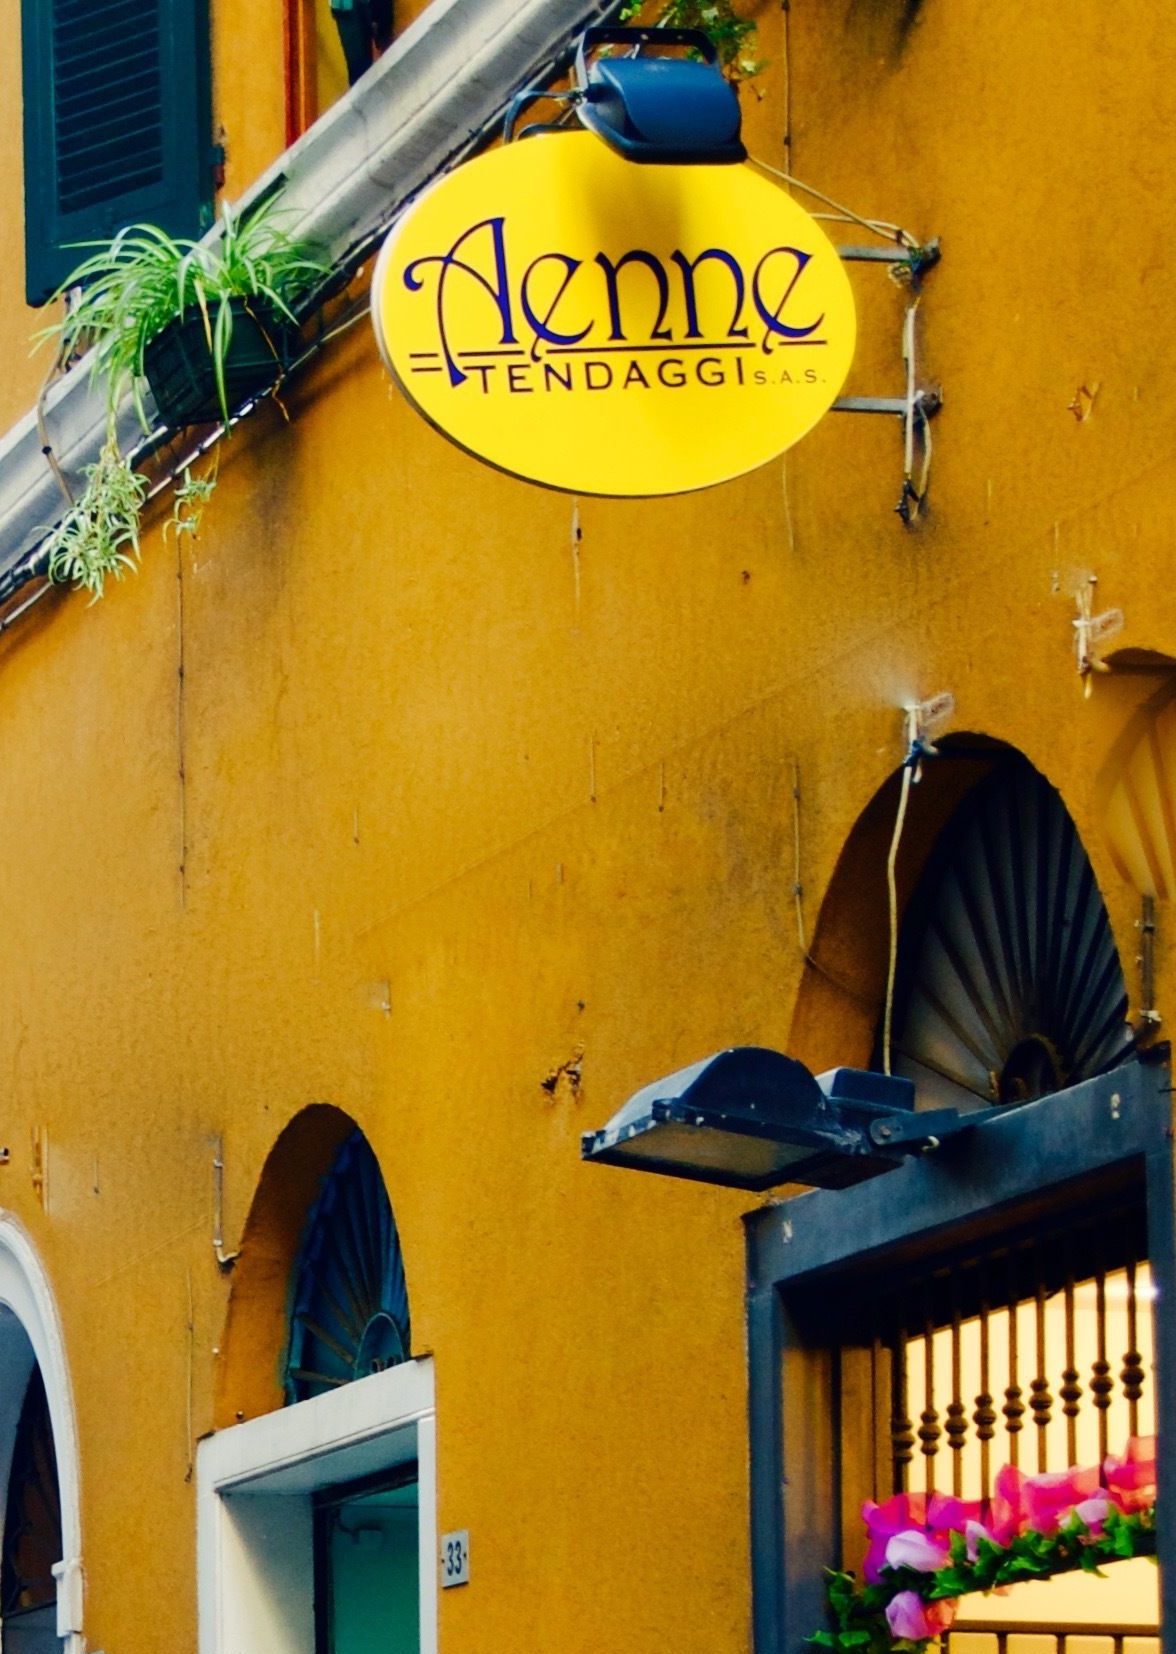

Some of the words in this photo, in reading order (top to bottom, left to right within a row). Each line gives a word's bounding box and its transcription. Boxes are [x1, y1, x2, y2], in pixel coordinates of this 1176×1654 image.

[403, 216, 825, 389] Aenne
[464, 355, 745, 395] TENDAGGI
[753, 367, 827, 387] S.A.S.
[447, 1540, 462, 1576] 33
